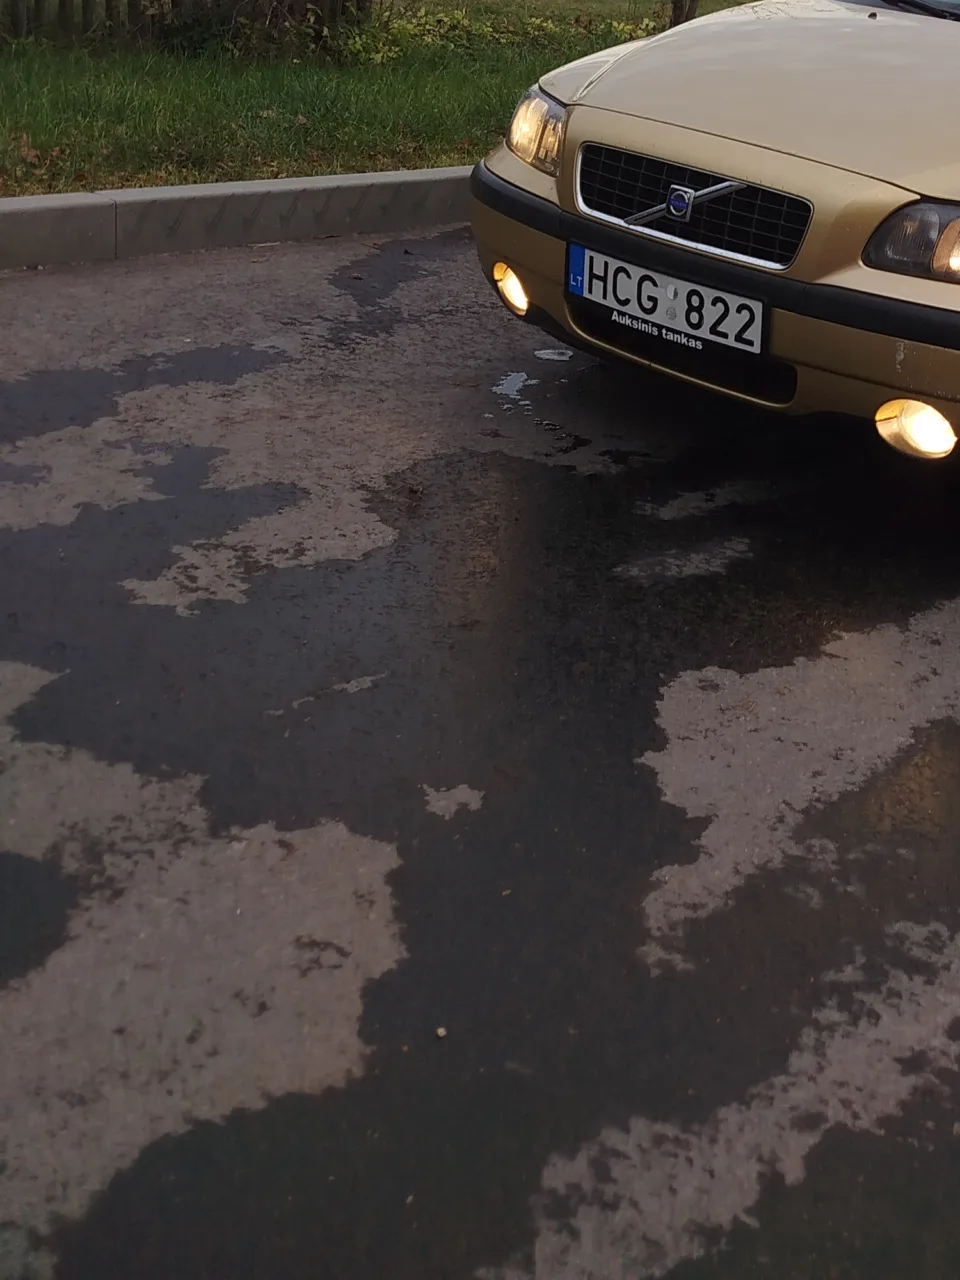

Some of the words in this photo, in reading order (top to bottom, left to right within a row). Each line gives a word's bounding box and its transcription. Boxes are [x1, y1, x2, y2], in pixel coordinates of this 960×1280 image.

[570, 273, 583, 288] LT
[587, 255, 660, 316] HCG
[684, 288, 756, 348] 822
[611, 310, 659, 336] Auksinis
[661, 327, 703, 350] tankas
